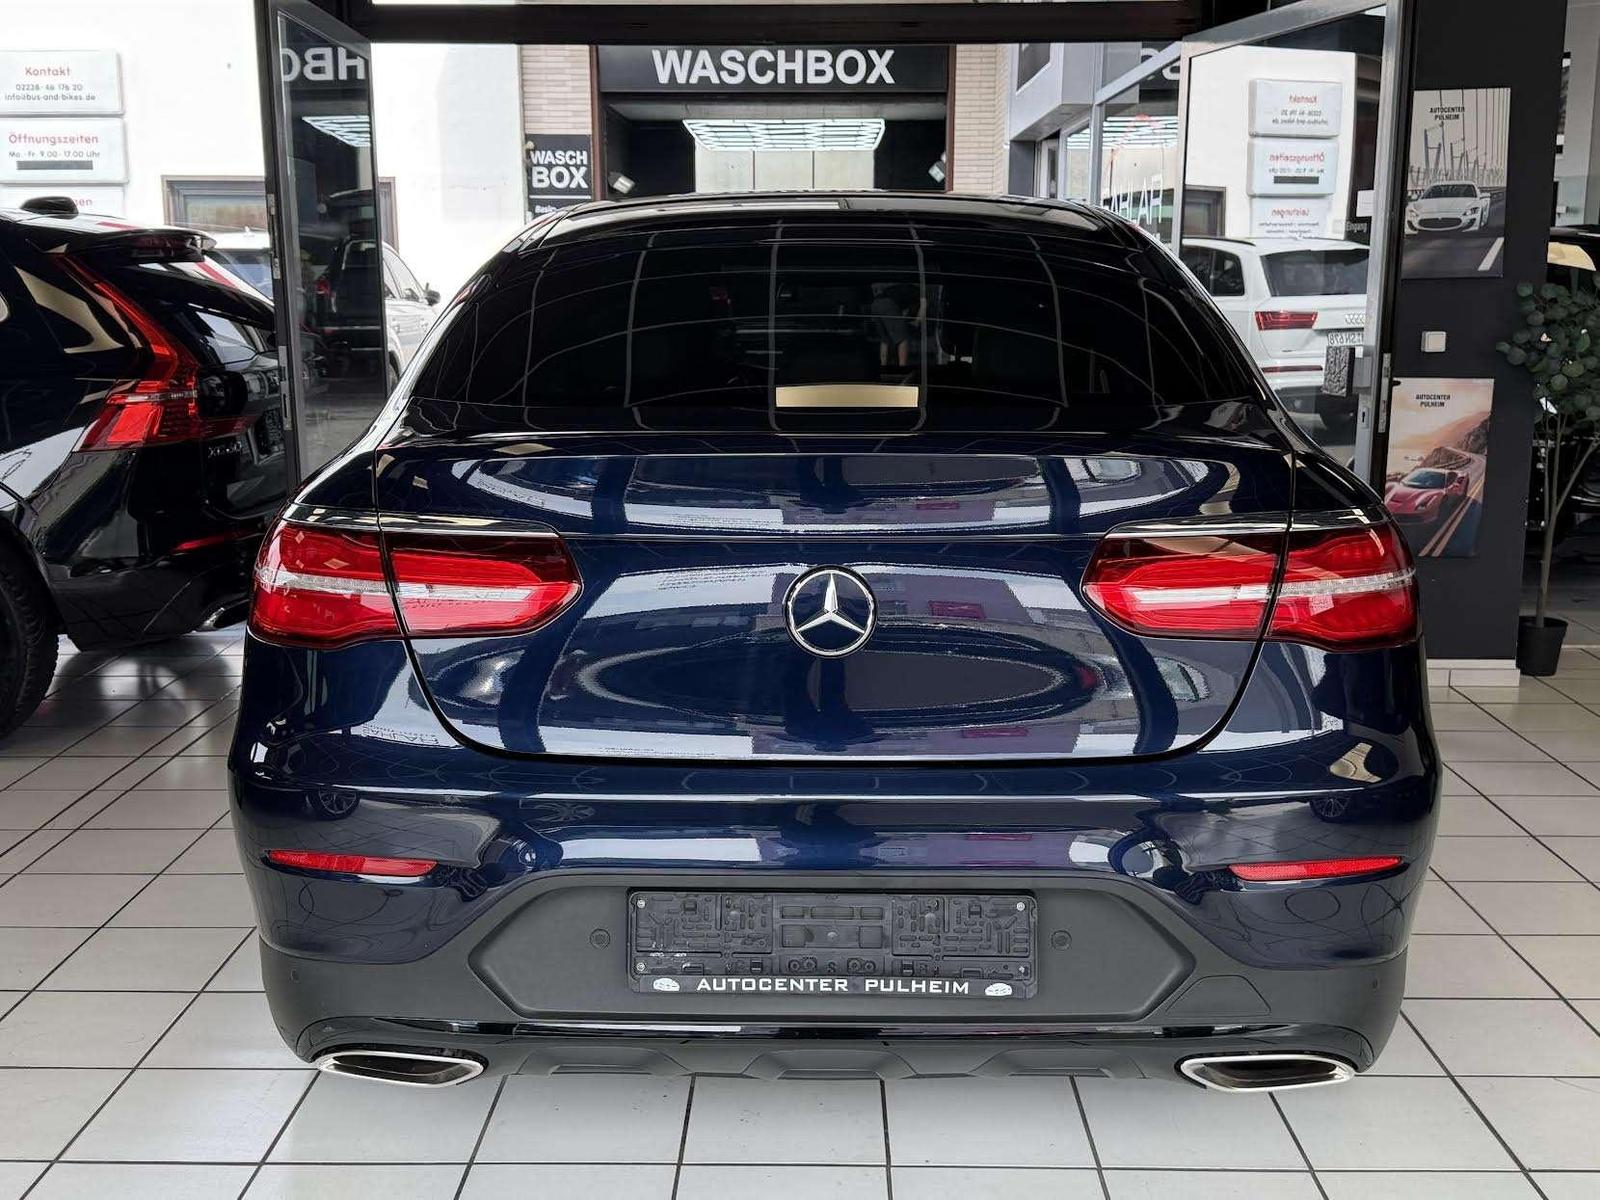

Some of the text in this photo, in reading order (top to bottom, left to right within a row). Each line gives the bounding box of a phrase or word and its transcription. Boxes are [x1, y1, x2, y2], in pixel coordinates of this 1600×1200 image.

[25, 66, 71, 76] Kontakt
[652, 49, 896, 85] WASCHBOX
[8, 132, 99, 145] Öffnungszeiten
[86, 150, 100, 158] Uhr
[530, 150, 588, 165] WASCH
[531, 166, 589, 189] BOX
[697, 977, 969, 994] AUTOCENTER PULHEIM
